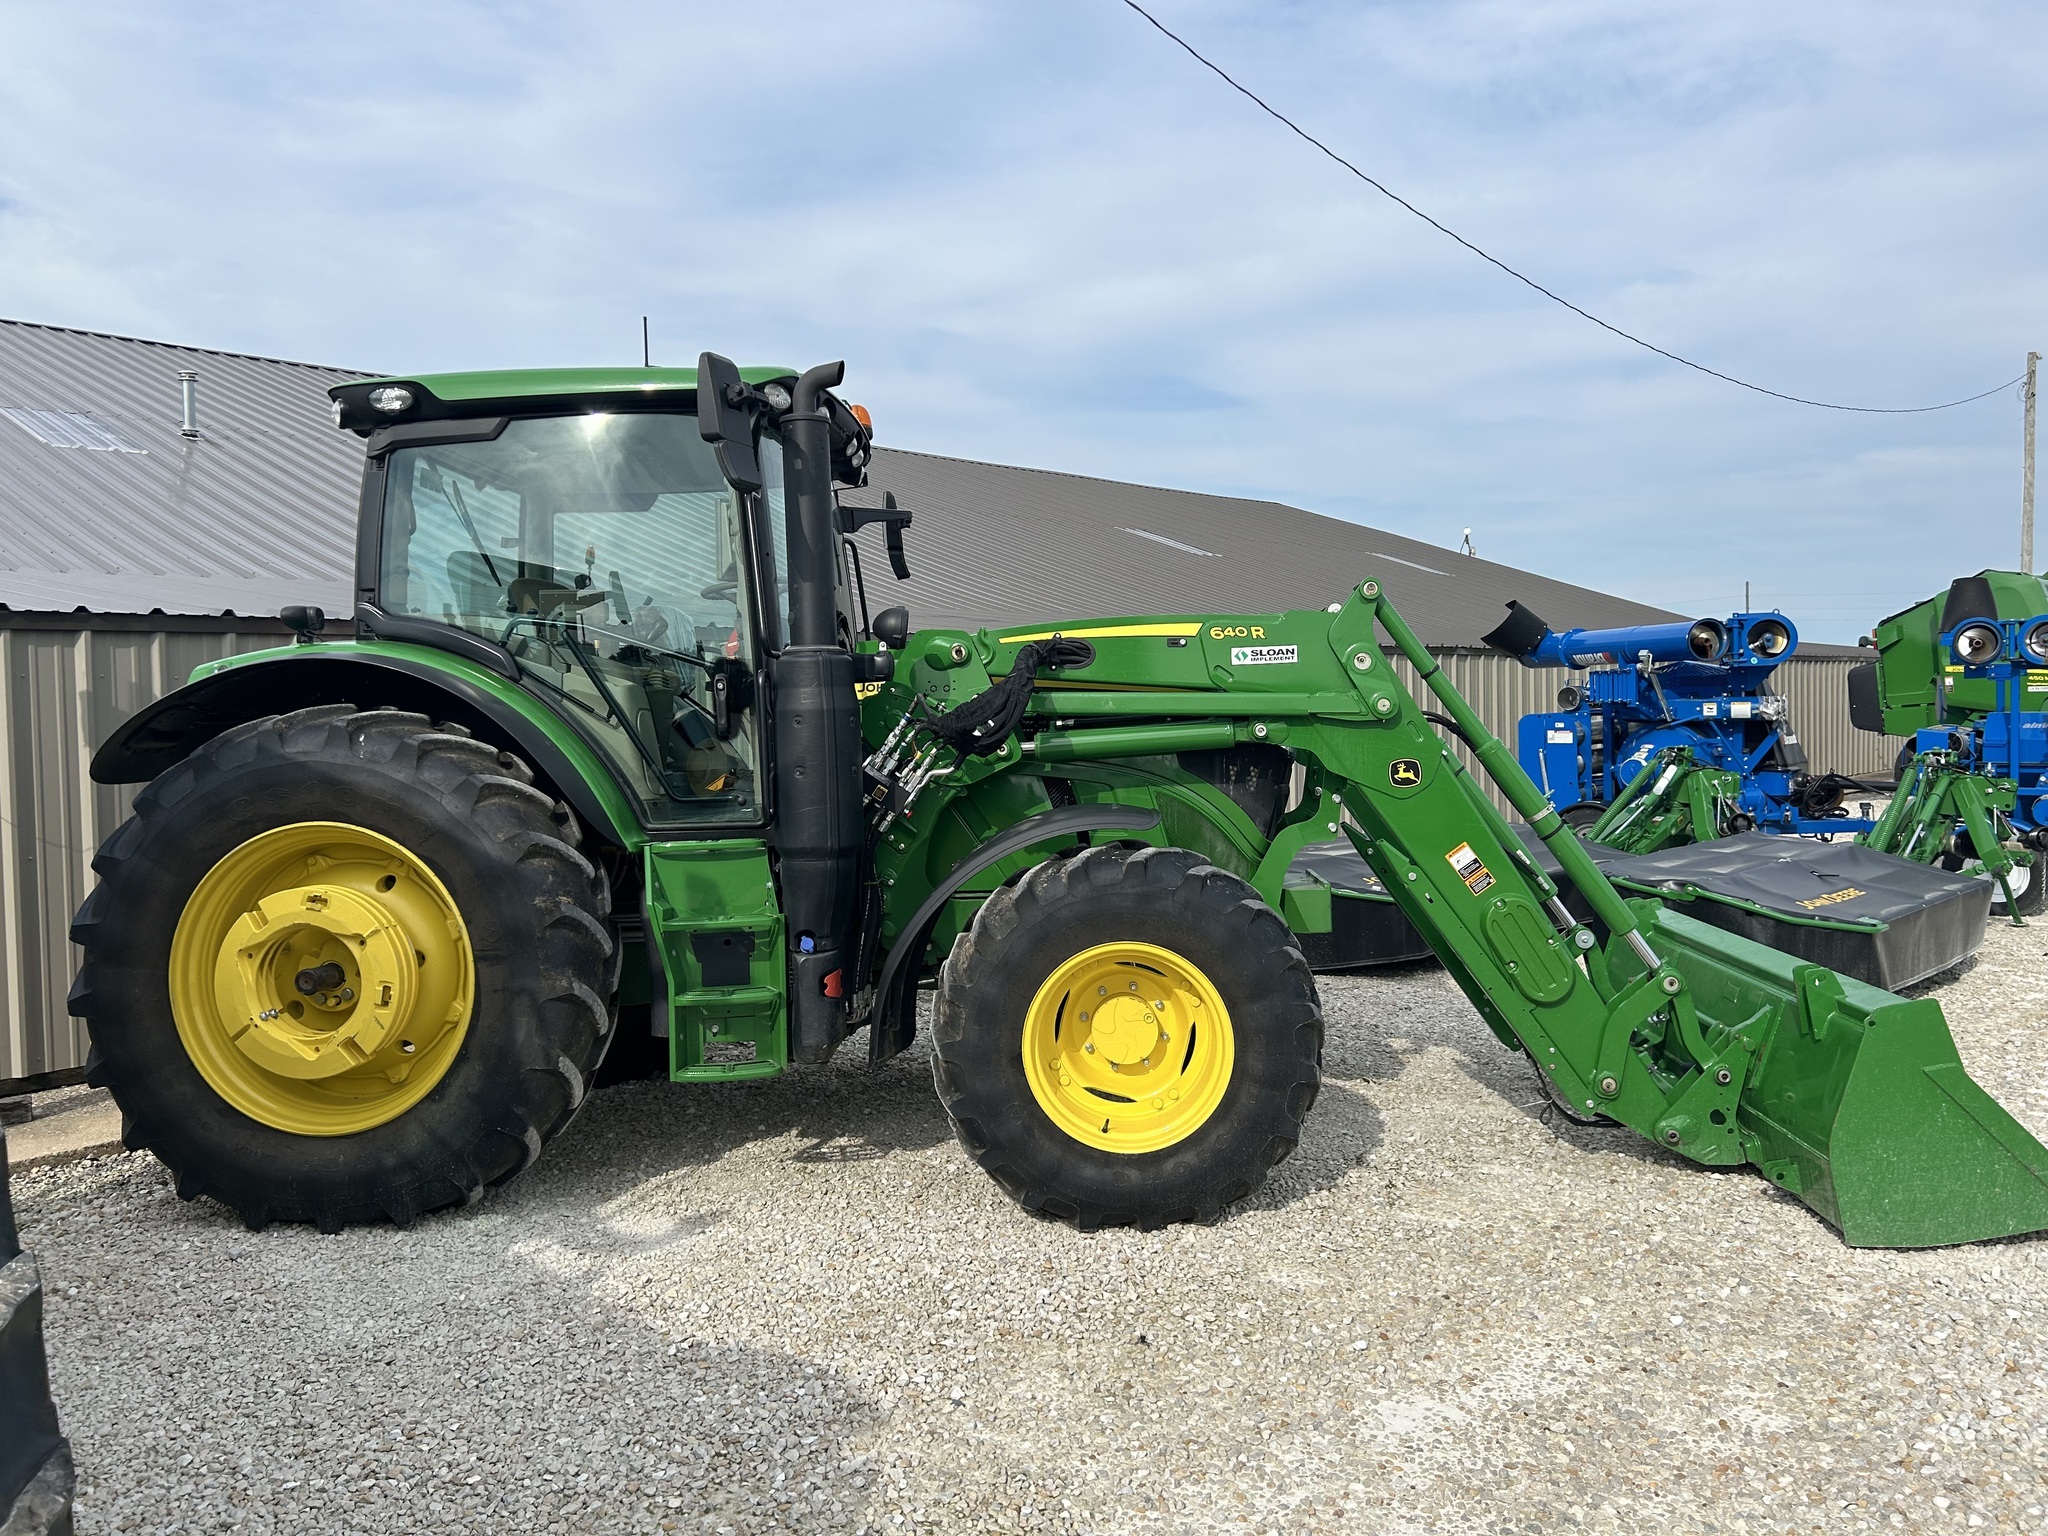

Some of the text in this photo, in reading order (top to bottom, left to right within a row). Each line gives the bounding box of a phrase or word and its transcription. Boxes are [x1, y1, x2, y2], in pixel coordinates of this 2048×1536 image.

[1209, 626, 1267, 640] 640 R
[1250, 648, 1295, 657] SLOAN
